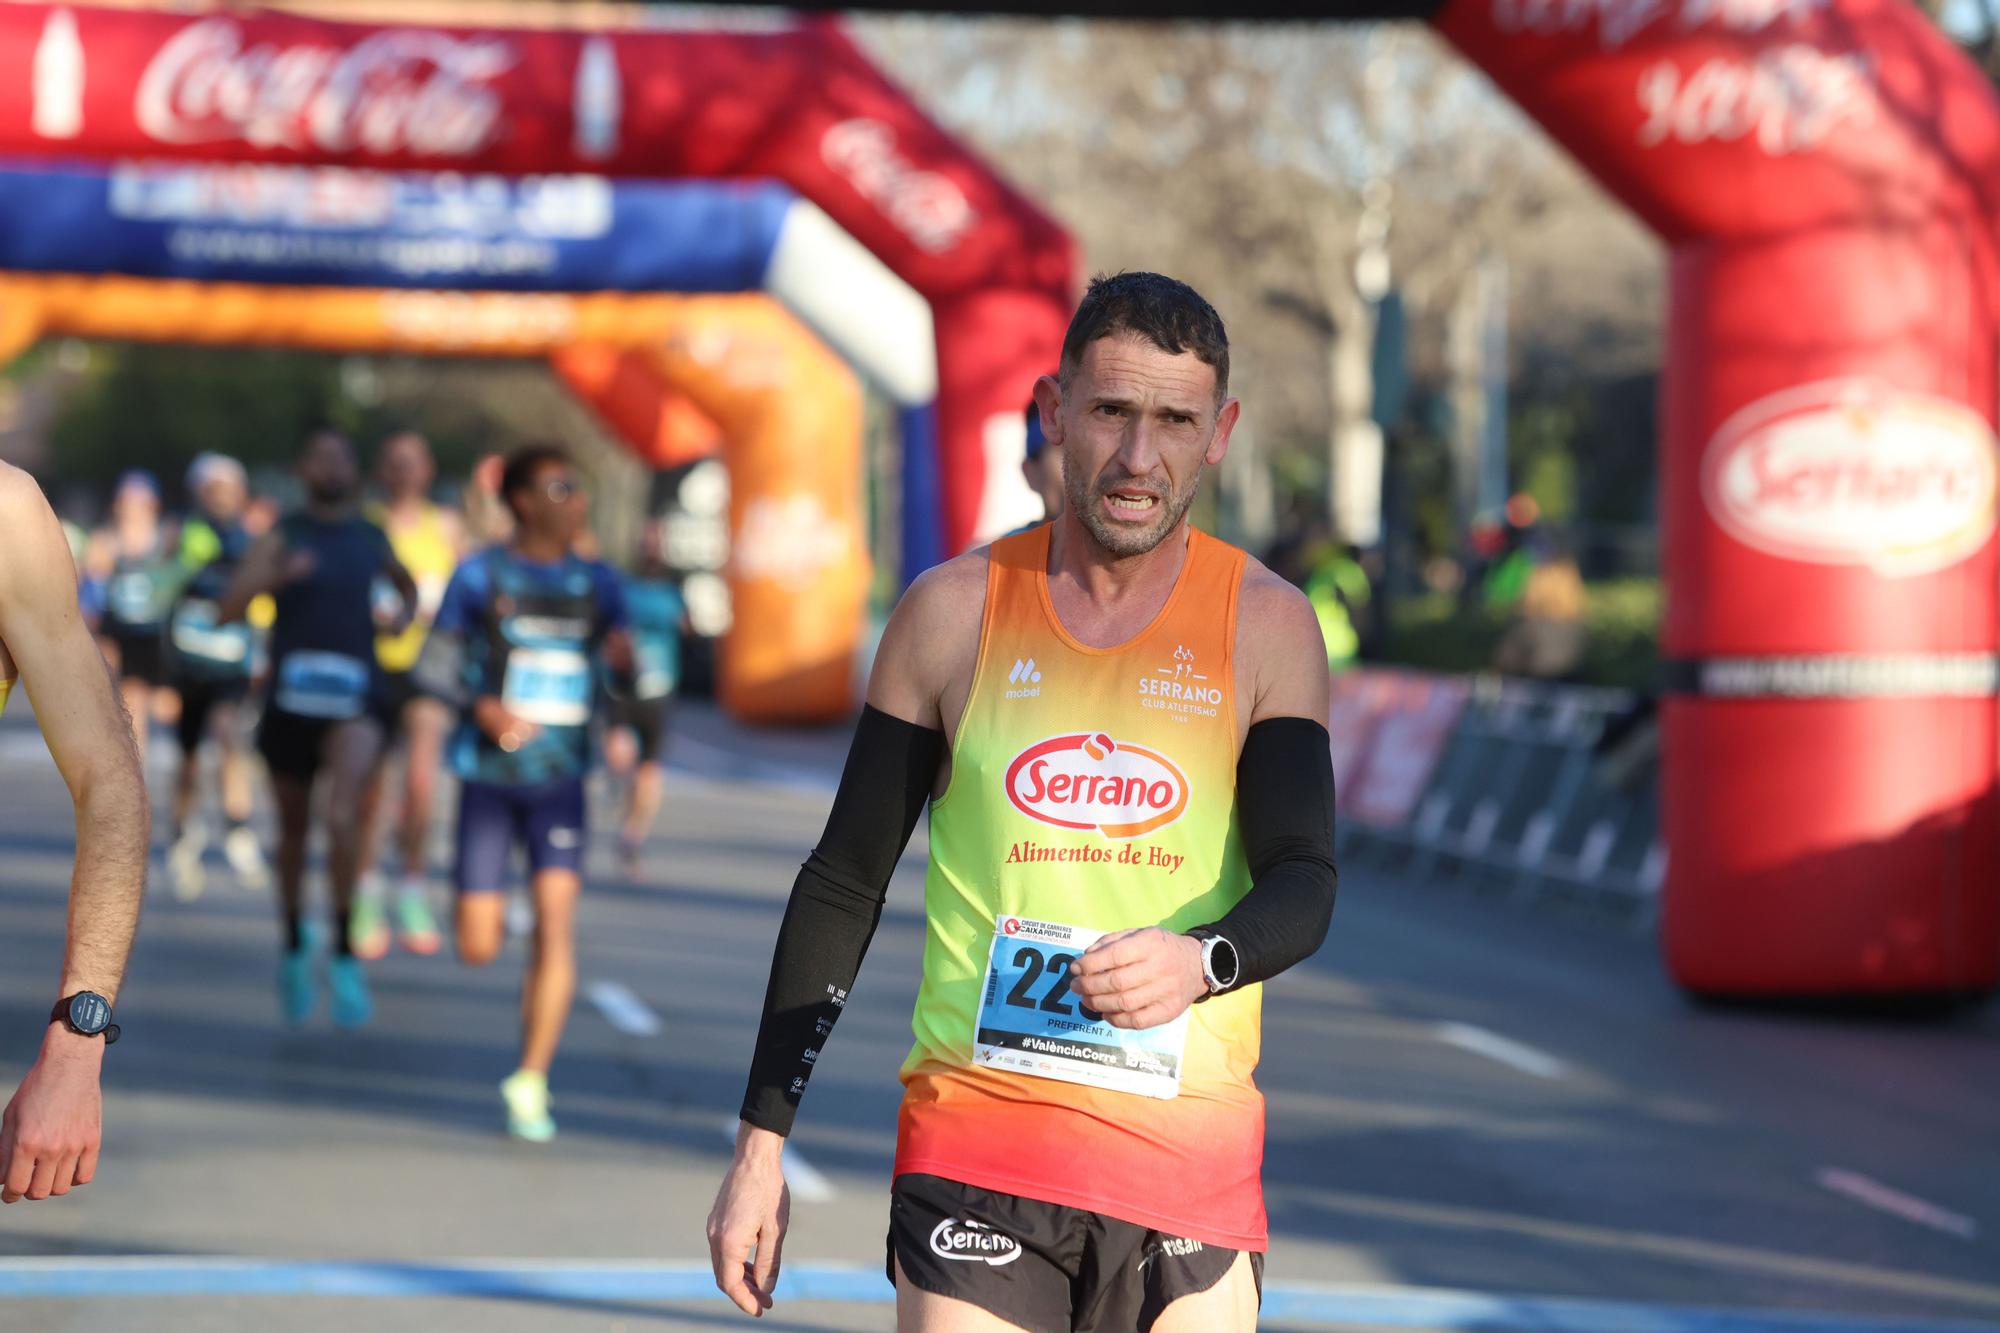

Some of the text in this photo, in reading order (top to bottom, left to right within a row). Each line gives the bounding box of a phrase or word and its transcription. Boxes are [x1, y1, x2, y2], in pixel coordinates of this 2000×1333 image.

[1139, 678, 1222, 705] SERRANO
[1141, 698, 1217, 717] CLUB ATLETISMO
[1022, 759, 1173, 809] Serrano
[1006, 840, 1185, 875] Alimentos de Hoy
[1022, 920, 1039, 928] CIRCUIT
[1047, 924, 1072, 933] CARRERES
[1043, 929, 1072, 940] POPULAR
[1048, 1018, 1113, 1038] PREFERENT A
[1022, 1037, 1117, 1065] #ValènciaCorre
[940, 1226, 1014, 1251] Serrano
